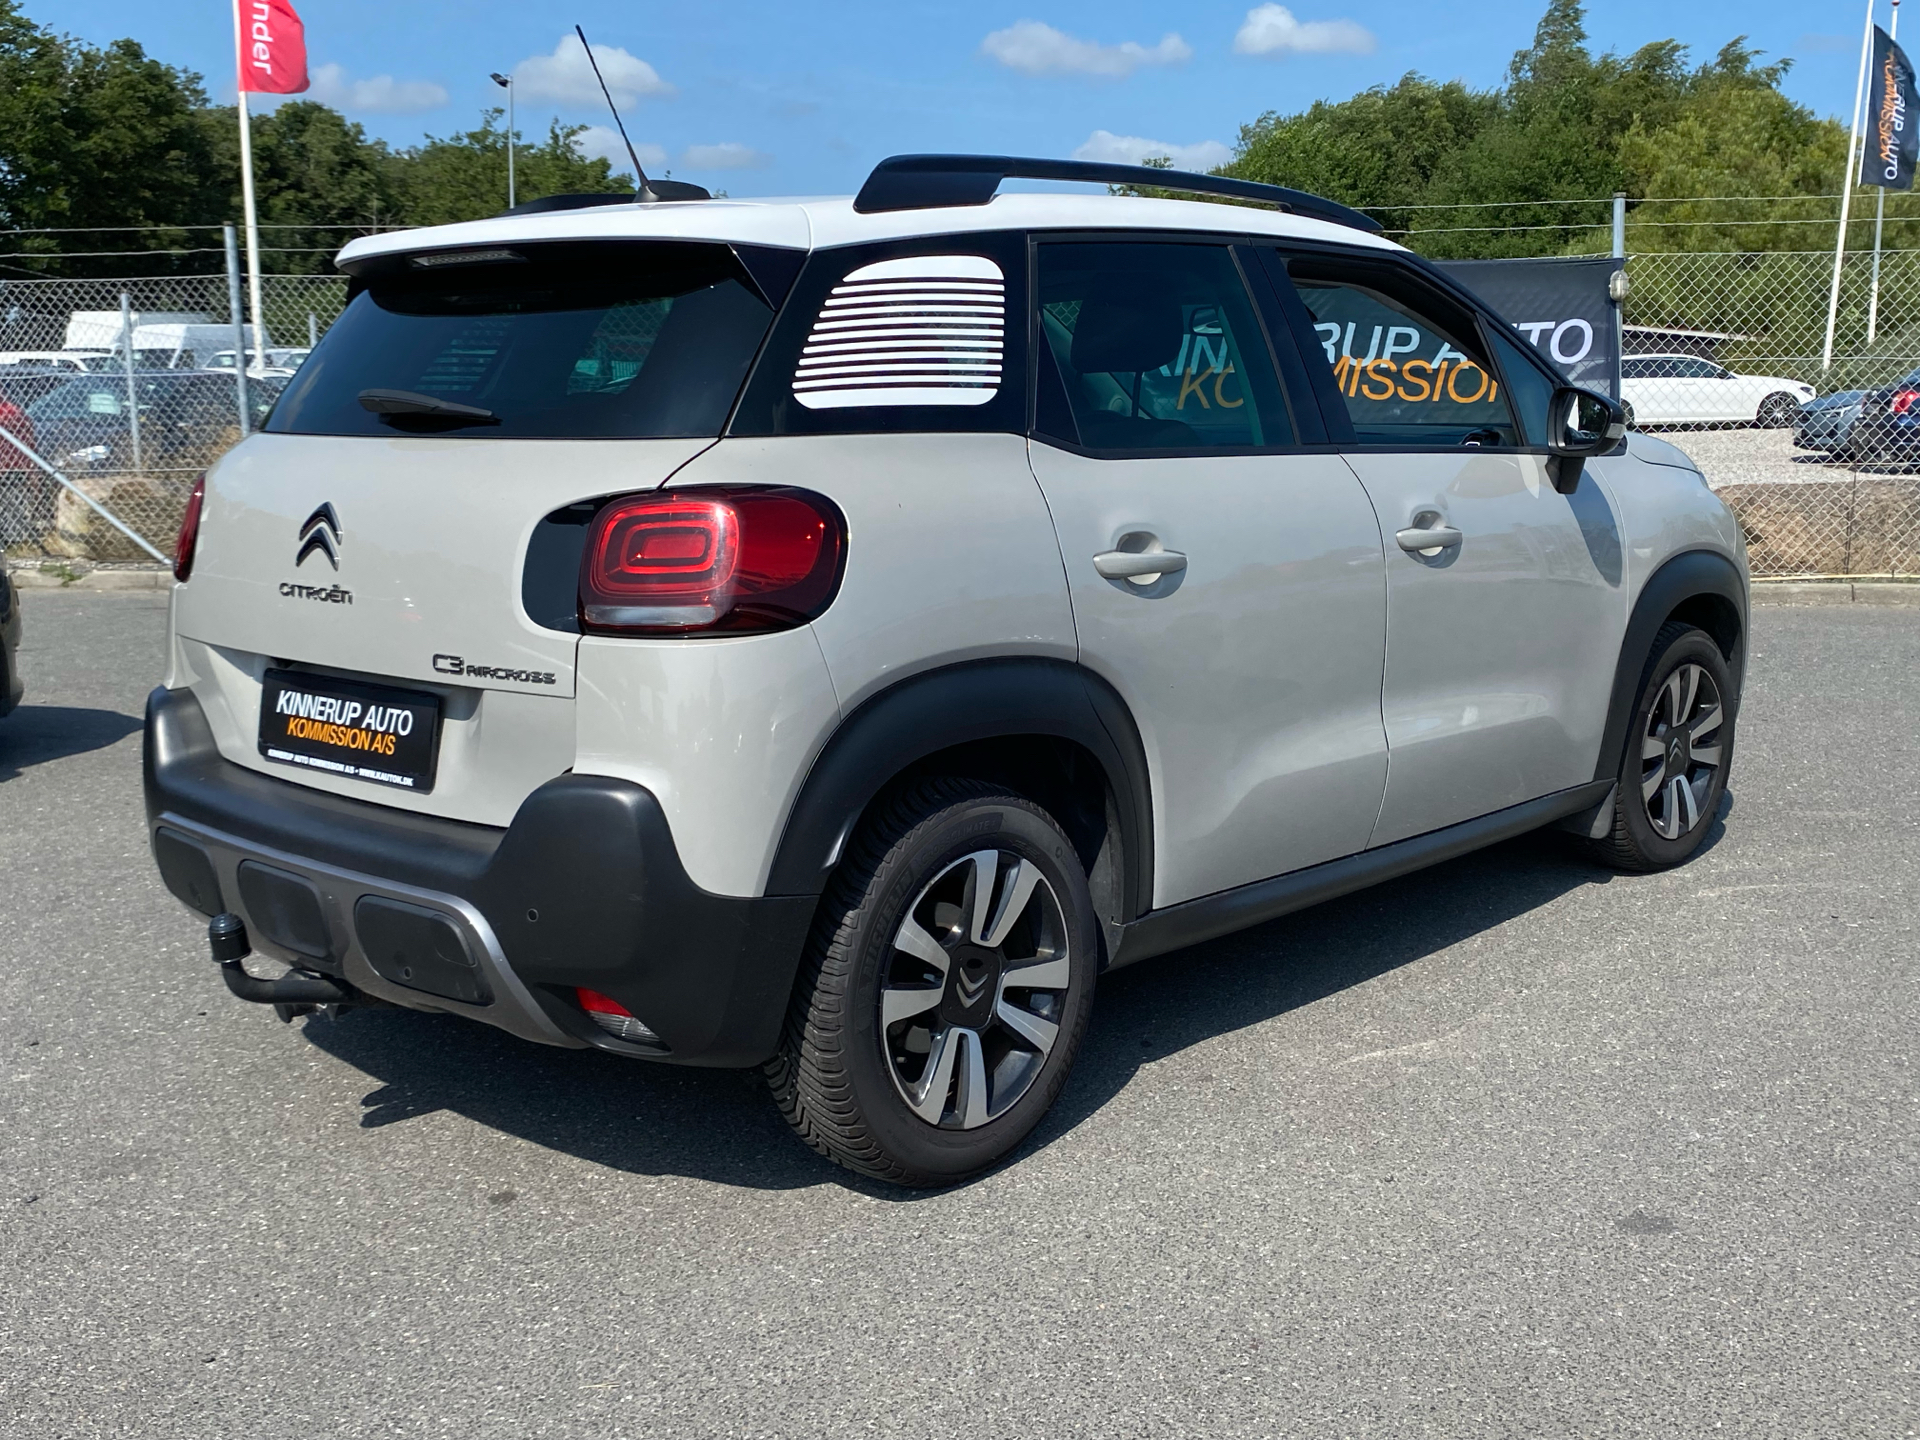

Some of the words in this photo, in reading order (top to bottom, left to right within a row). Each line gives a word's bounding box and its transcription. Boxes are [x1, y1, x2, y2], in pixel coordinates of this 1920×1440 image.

[252, 0, 274, 75] nder
[1884, 134, 1901, 180] AUTO
[432, 653, 465, 676] C3
[466, 665, 556, 685] AIRCROSS
[275, 689, 362, 726] KINNERUP
[361, 705, 413, 736] AUTO
[286, 716, 371, 751] KOMMISSION
[371, 733, 396, 756] A/S
